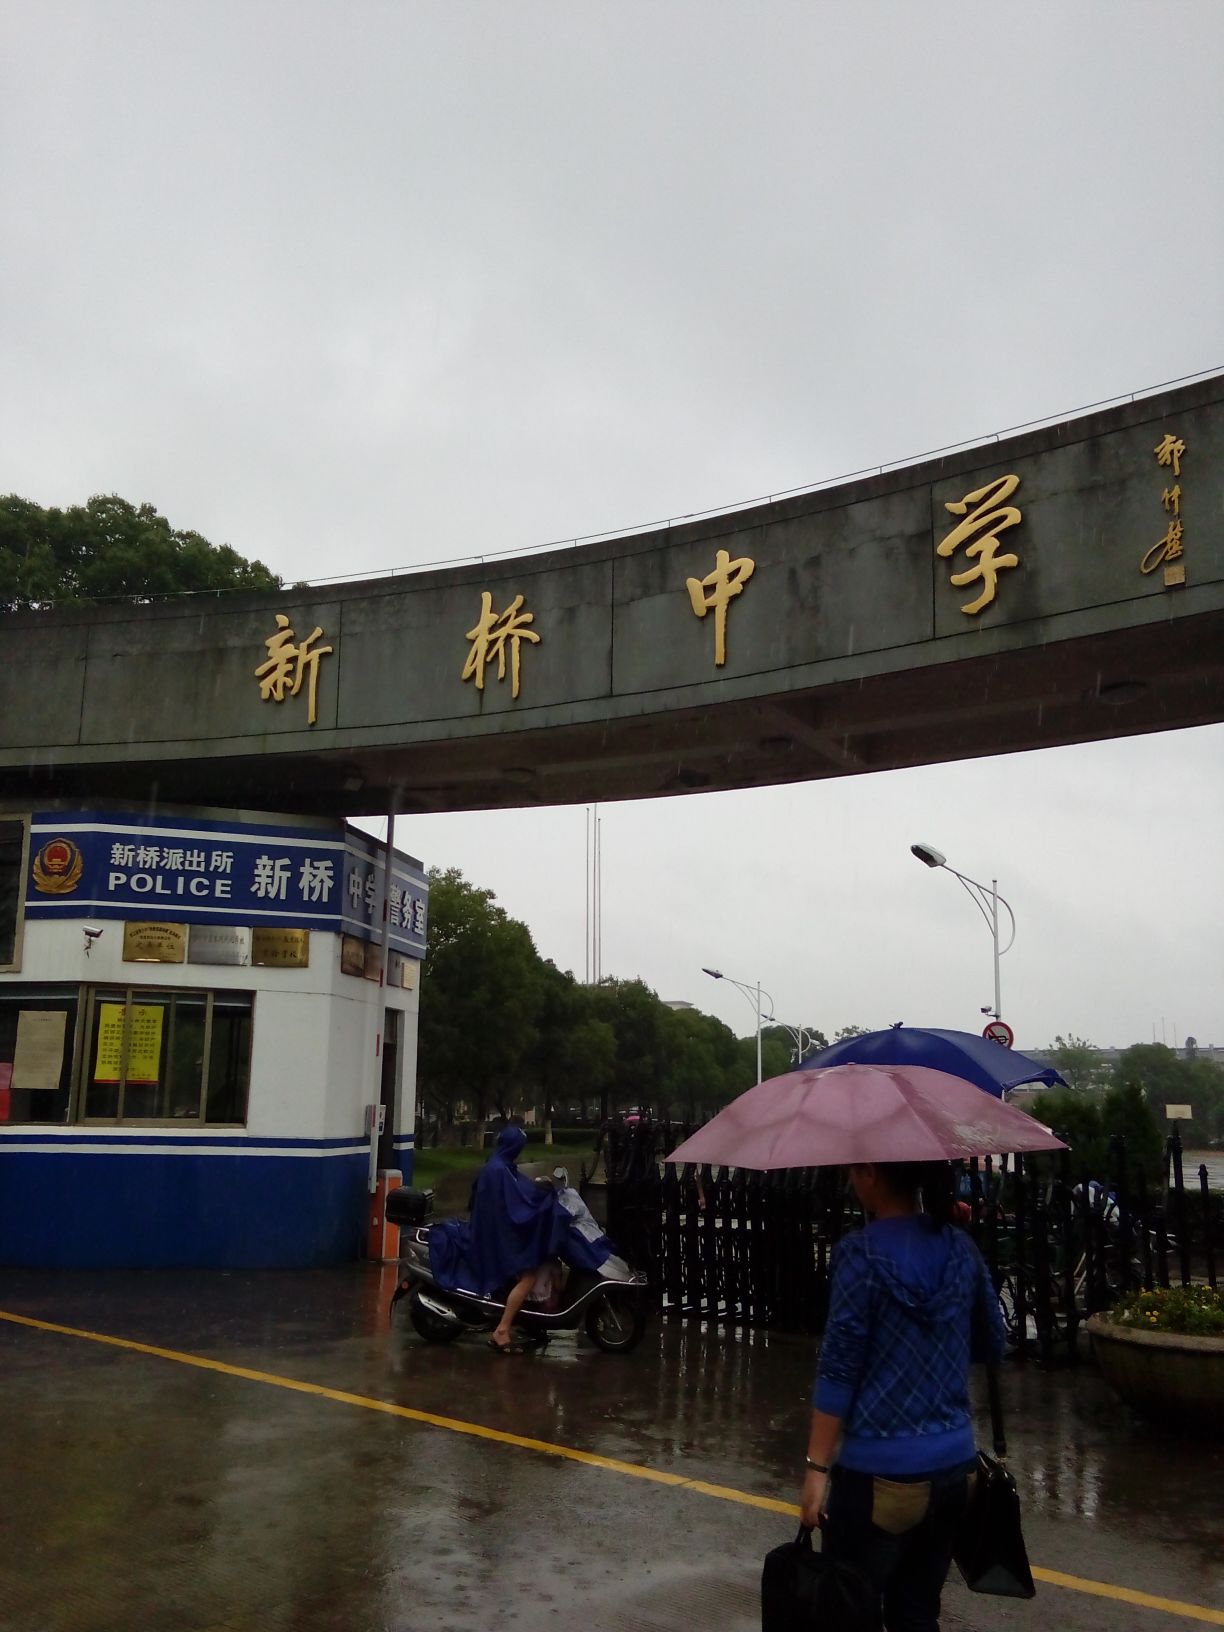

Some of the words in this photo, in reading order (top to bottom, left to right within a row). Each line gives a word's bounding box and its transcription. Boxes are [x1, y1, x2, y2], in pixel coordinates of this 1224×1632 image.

[254, 474, 1022, 724] 新桥中学
[109, 843, 234, 873] 新桥派出所
[107, 872, 232, 899] POLICE
[250, 855, 334, 903] 新桥
